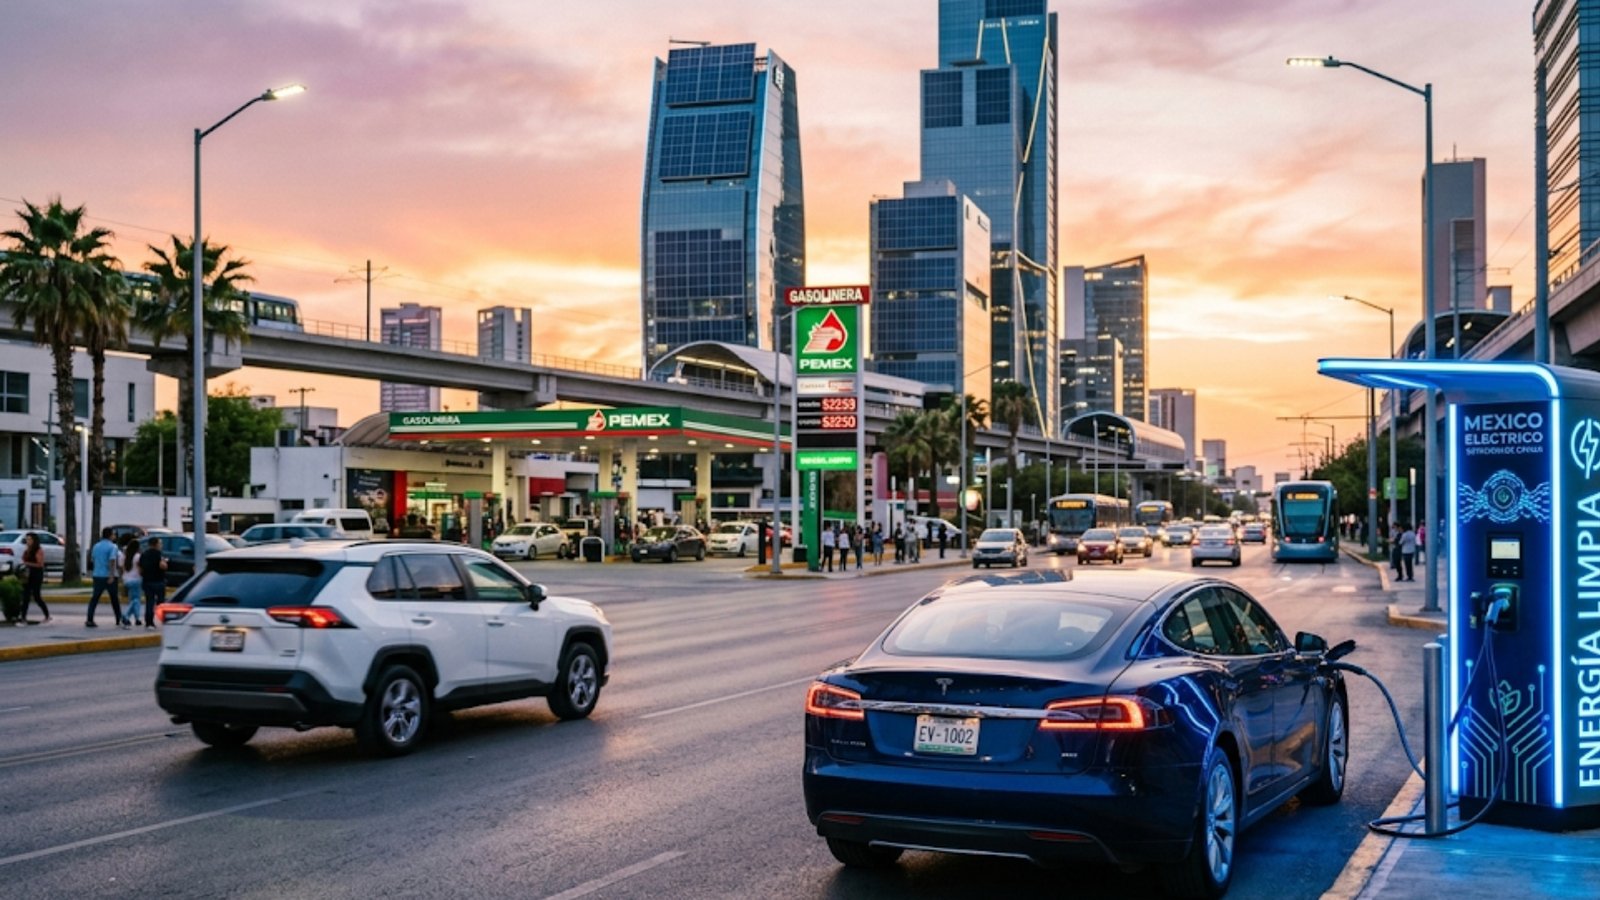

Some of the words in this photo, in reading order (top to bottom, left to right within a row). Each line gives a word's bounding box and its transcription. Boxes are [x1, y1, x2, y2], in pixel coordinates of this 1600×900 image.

[790, 288, 863, 303] GASOLINERA
[800, 358, 852, 369] PEMEX
[609, 413, 671, 427] PEMEX
[1464, 412, 1543, 431] MEXICO
[1464, 431, 1544, 445] ELECTRICO
[1577, 491, 1600, 619] LIMPIA
[1571, 629, 1600, 787] ENERGÍA
[918, 726, 974, 744] EV-1002
